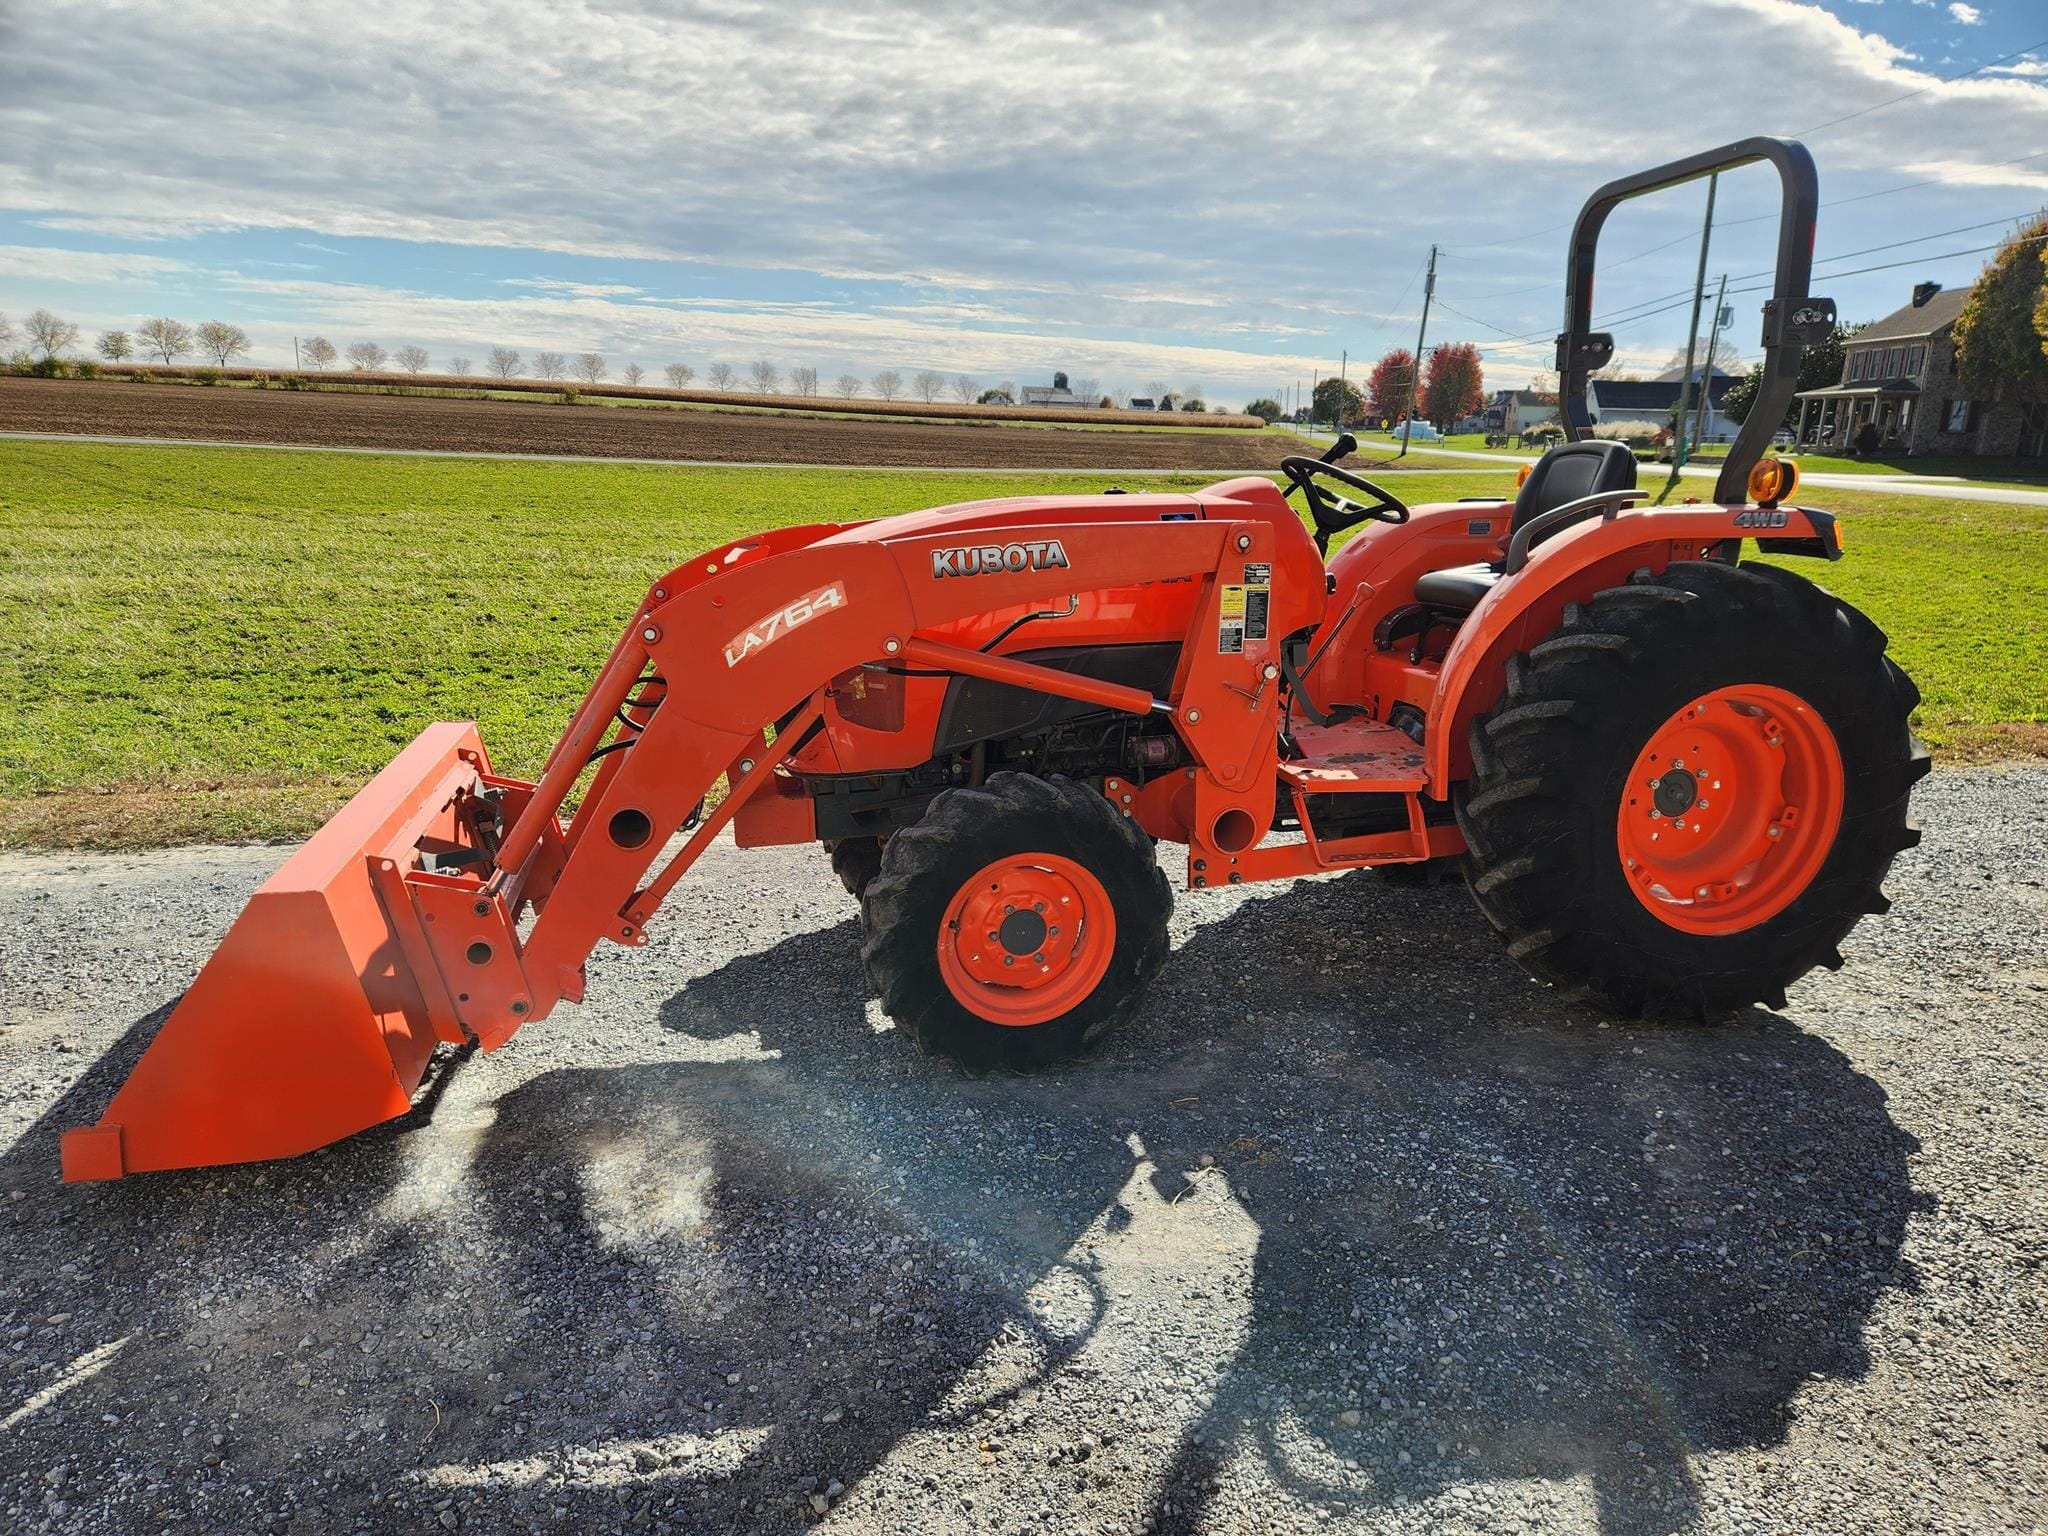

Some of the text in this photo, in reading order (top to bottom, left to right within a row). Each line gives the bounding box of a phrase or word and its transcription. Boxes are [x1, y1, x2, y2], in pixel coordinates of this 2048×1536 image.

[1733, 511, 1788, 528] 4WD
[932, 541, 1070, 579] KUBOTA
[725, 588, 843, 668] LA764
